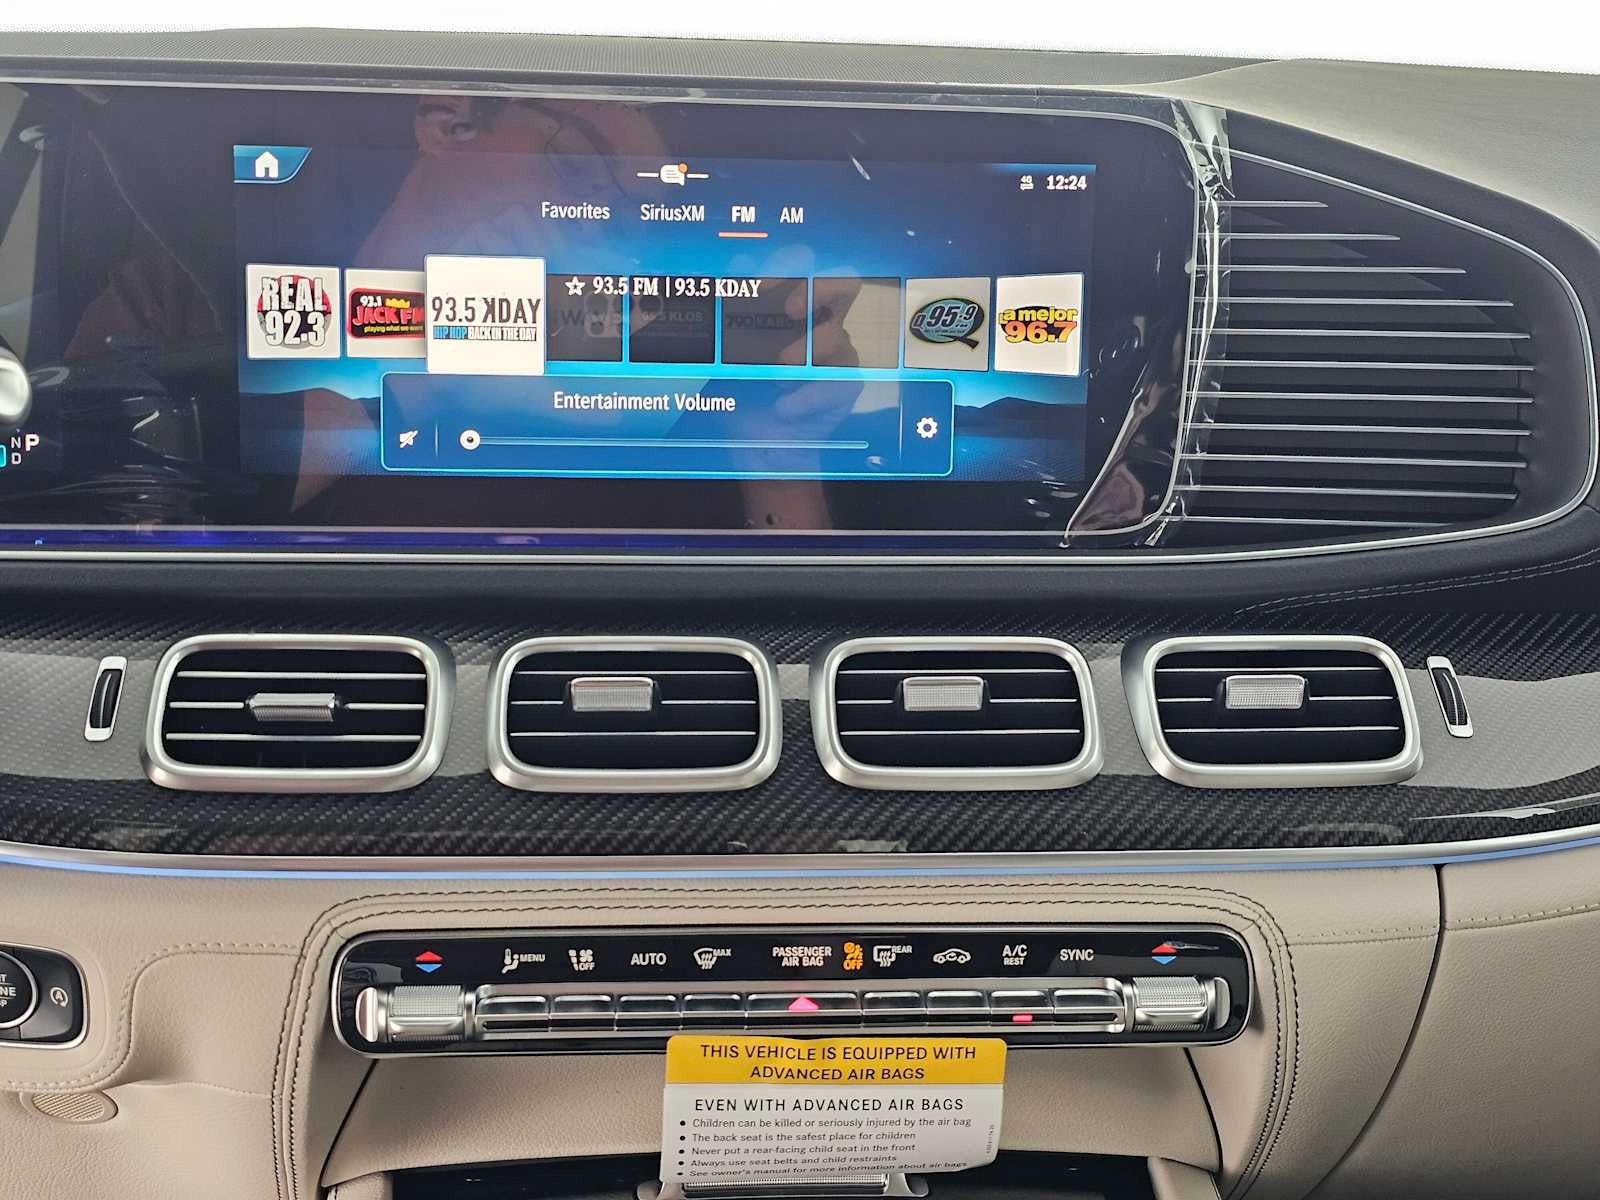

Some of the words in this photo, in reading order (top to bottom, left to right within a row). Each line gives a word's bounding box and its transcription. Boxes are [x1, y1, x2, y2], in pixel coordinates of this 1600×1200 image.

[1046, 174, 1088, 191] 12:24
[541, 201, 611, 220] Favorites
[640, 203, 705, 221] SiriusXM
[731, 205, 756, 223] FM
[779, 207, 804, 224] AM
[261, 276, 328, 312] REAL
[592, 276, 629, 296] 93.5
[633, 277, 659, 296] FM
[674, 277, 711, 297] 93.5
[714, 278, 762, 298] KDAY
[352, 306, 400, 326] JACK
[431, 296, 476, 323] 93.5
[482, 297, 542, 324] KDAY
[926, 302, 979, 329] 95.9
[1018, 306, 1079, 324] mejor
[264, 310, 327, 346] 92.3
[433, 326, 449, 340] HIP
[449, 326, 467, 340] HOP
[468, 327, 491, 340] BACK
[503, 327, 520, 341] THE
[520, 328, 537, 341] DAY
[1004, 320, 1079, 344] 96.7
[553, 391, 669, 411] Entertainment
[674, 393, 736, 411] Volume
[10, 436, 21, 449] N
[25, 433, 40, 452] P
[11, 452, 21, 465] D
[713, 948, 732, 957] MAX
[772, 946, 832, 957] PASSENGER
[891, 945, 913, 954] REAR
[1002, 944, 1028, 957] A/C
[1059, 948, 1094, 961] SYNC
[519, 953, 546, 962] MENU
[630, 952, 667, 966] AUTO
[781, 956, 800, 967] AIR
[802, 956, 825, 967] BAG
[1003, 957, 1025, 966] REST
[579, 962, 595, 971] OFF
[843, 959, 864, 971] OFF
[700, 1044, 739, 1058] THIS
[744, 1045, 816, 1061] VEHICLE
[822, 1046, 837, 1060] IS
[843, 1046, 928, 1060] EQUIPPED
[933, 1046, 976, 1060] WITH
[750, 1065, 843, 1080] ADVANCED
[848, 1068, 876, 1080] AIR
[881, 1067, 925, 1080] BAGS
[695, 1099, 737, 1111] EVEN
[744, 1099, 786, 1111] WITH
[792, 1098, 882, 1111] ADVANCED
[888, 1098, 915, 1111] AIR
[921, 1098, 964, 1111] BAGS
[692, 1118, 735, 1128] Children
[737, 1120, 756, 1128] can
[759, 1118, 771, 1127] be
[774, 1118, 801, 1128] killed
[818, 1118, 863, 1128] seriously
[866, 1117, 901, 1128] injured
[904, 1117, 916, 1128] by
[919, 1117, 934, 1126] the
[937, 1117, 951, 1126] air
[953, 1117, 972, 1128] bag
[692, 1133, 711, 1142] The
[713, 1132, 737, 1142] back
[741, 1134, 762, 1142] seat
[765, 1133, 774, 1141] is
[776, 1133, 793, 1141] the
[795, 1132, 826, 1141] safest
[828, 1132, 856, 1142] place
[859, 1131, 873, 1140] for
[875, 1131, 917, 1140] children
[691, 1147, 721, 1155] Never
[724, 1147, 741, 1156] put
[752, 1146, 806, 1155] rear-facing
[808, 1145, 833, 1153] child
[860, 1144, 870, 1152] in
[872, 1144, 889, 1152] the
[891, 1143, 916, 1151] front
[690, 1159, 726, 1167] Always
[750, 1158, 770, 1166] seat
[773, 1157, 798, 1165] belts
[822, 1156, 847, 1164] child
[849, 1155, 897, 1163] restraints
[711, 1168, 750, 1177] owner's
[753, 1167, 790, 1175] manual
[809, 1166, 835, 1174] more
[838, 1163, 895, 1172] information
